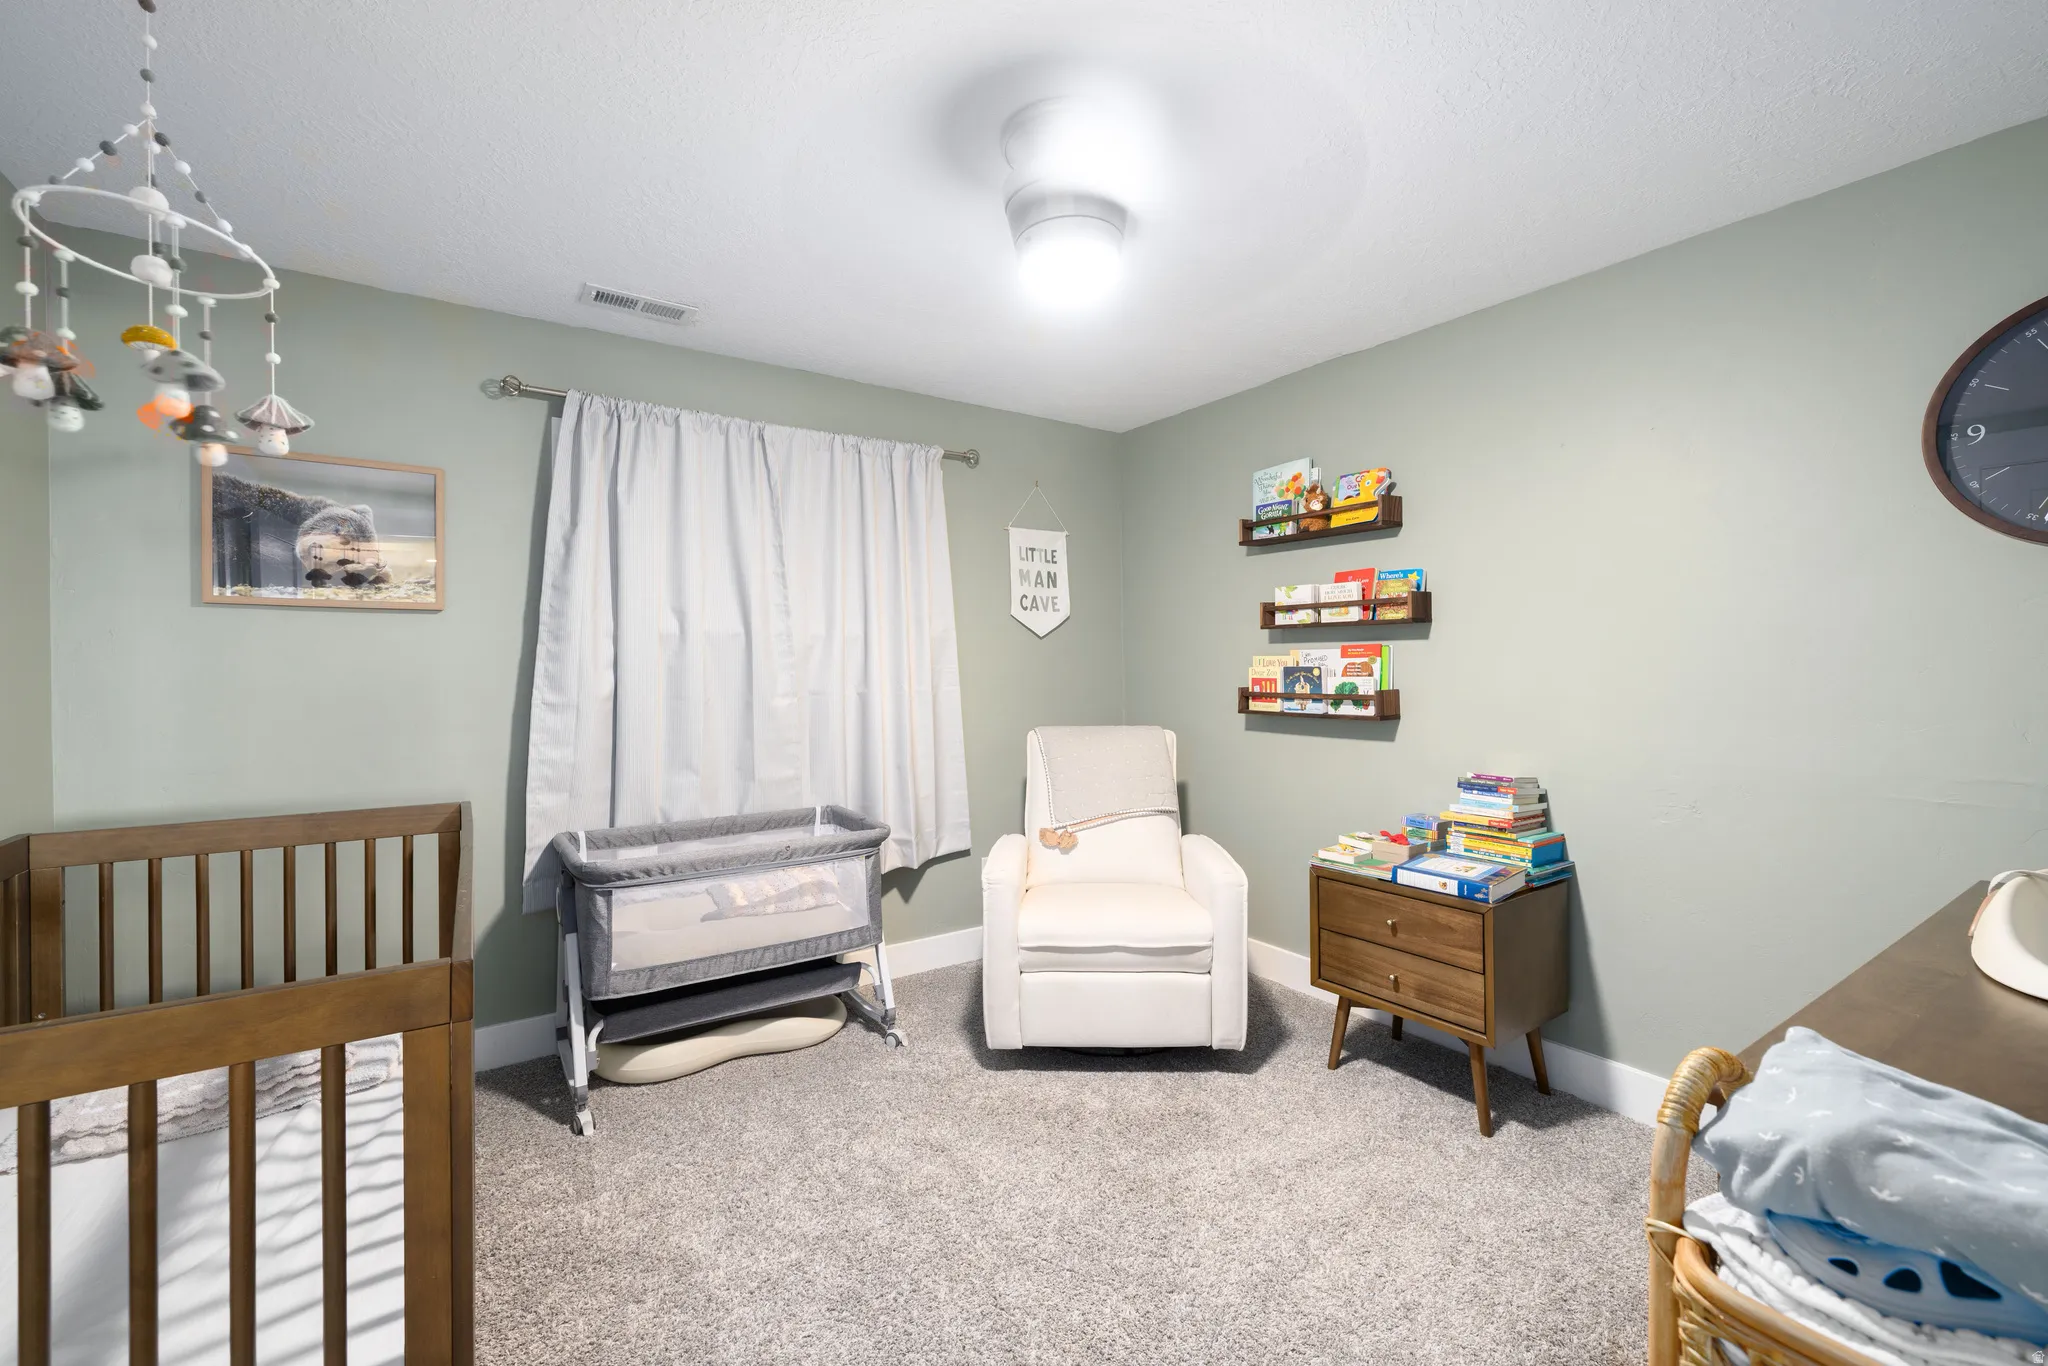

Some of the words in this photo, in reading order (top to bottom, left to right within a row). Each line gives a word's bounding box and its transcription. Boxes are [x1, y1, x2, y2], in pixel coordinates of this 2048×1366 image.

[2025, 327, 2038, 338] 55
[1969, 378, 1980, 388] 50
[1951, 432, 1959, 441] 45
[1966, 423, 1986, 446] 9
[1969, 480, 1980, 489] 40
[2025, 512, 2040, 521] 35
[1018, 545, 1058, 565] LITTLE
[1018, 568, 1058, 589] MAN
[1379, 571, 1404, 579] Where's
[1019, 593, 1061, 613] CAVE
[1251, 668, 1266, 676] Dear
[1266, 668, 1278, 676] Zoo
